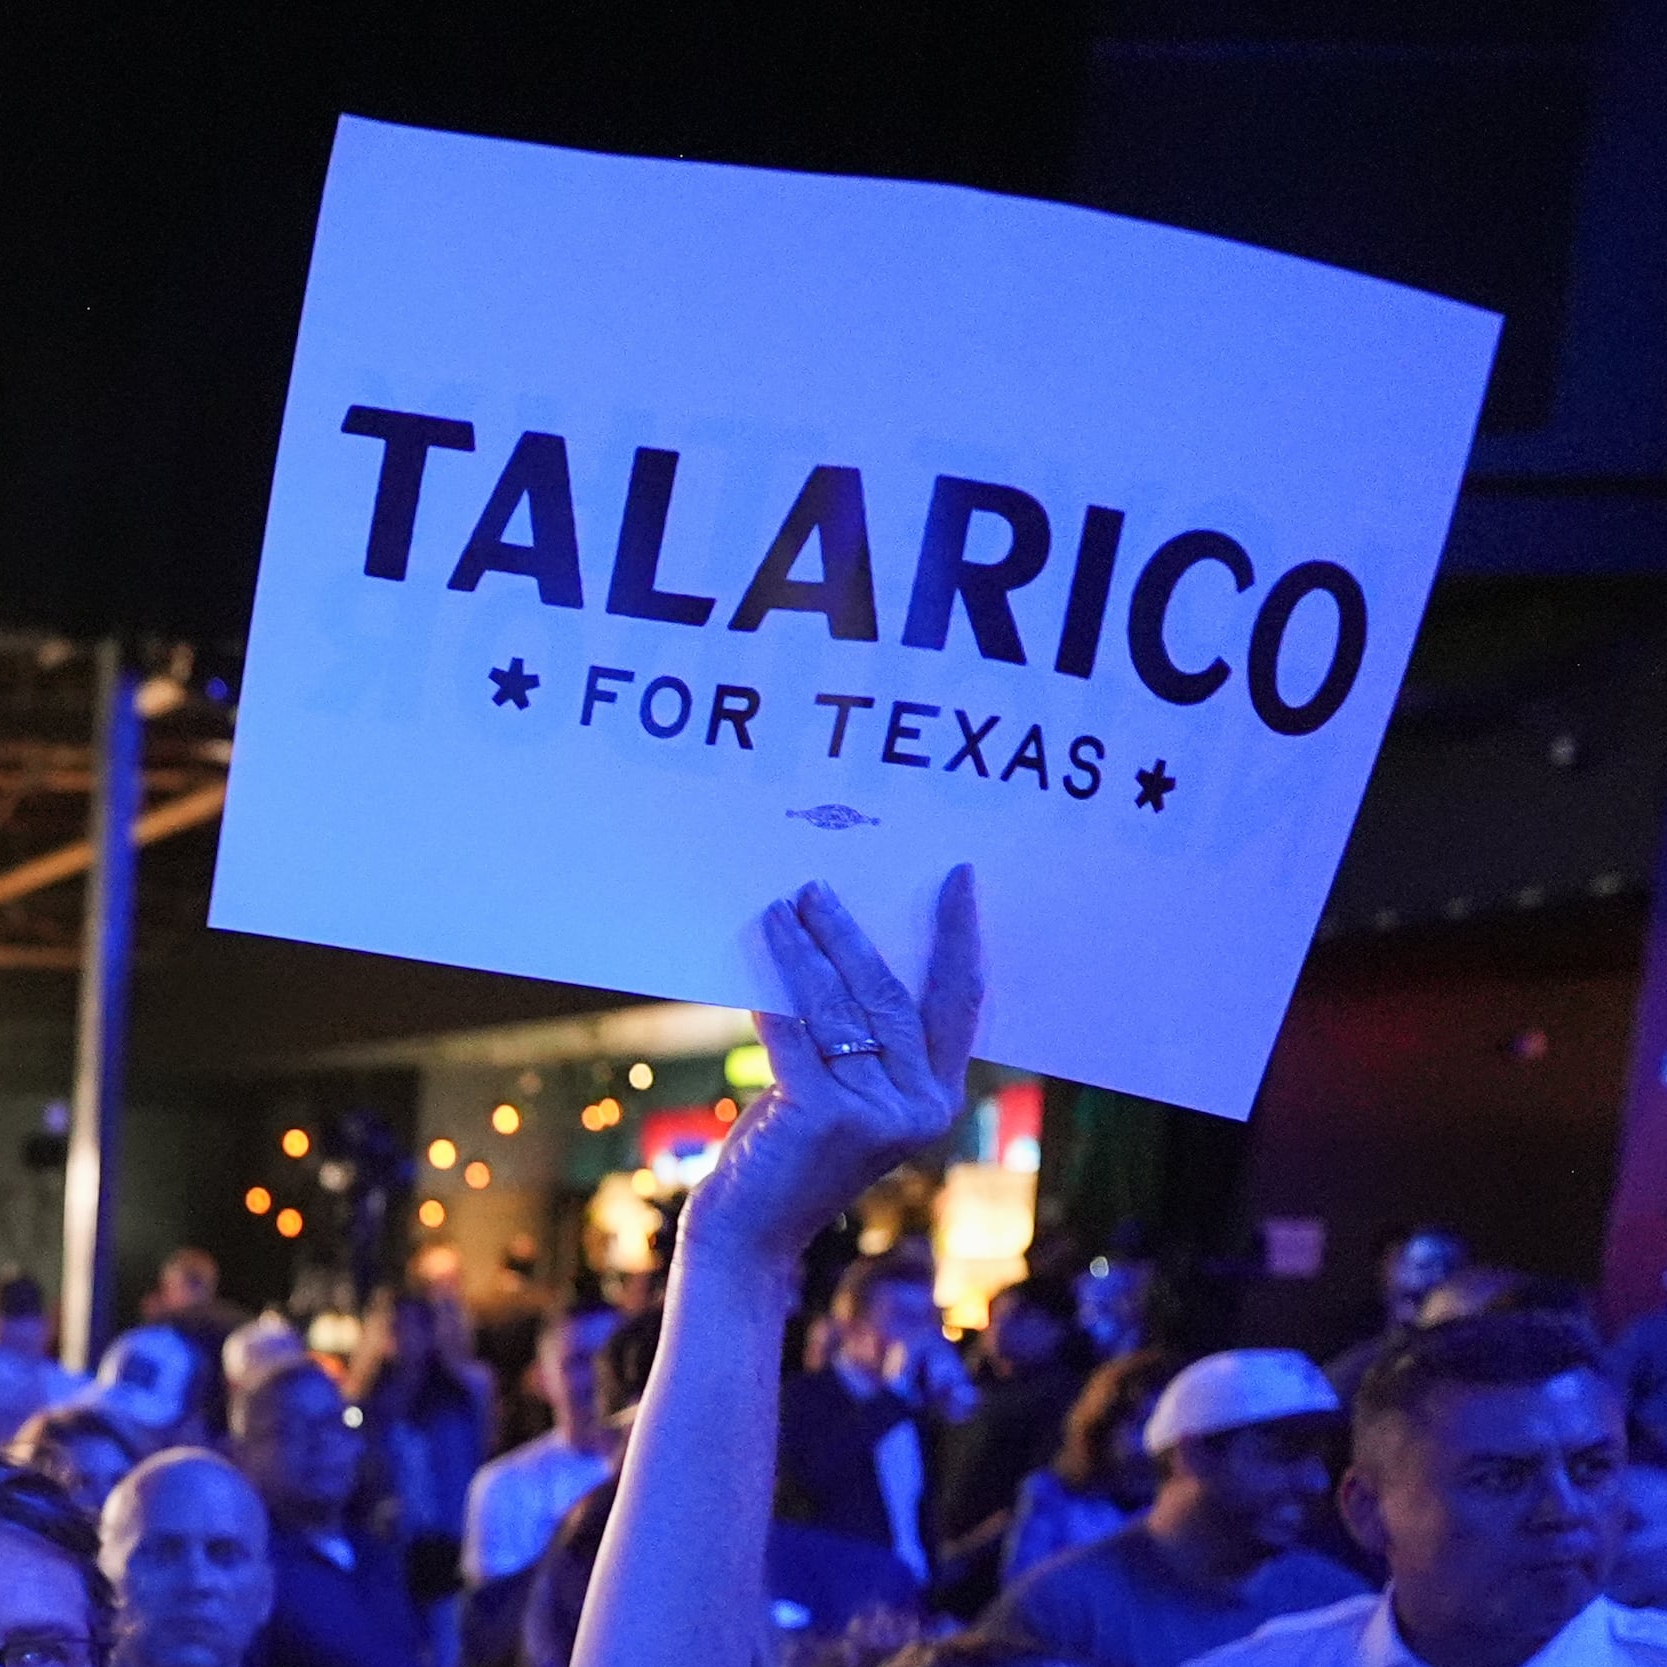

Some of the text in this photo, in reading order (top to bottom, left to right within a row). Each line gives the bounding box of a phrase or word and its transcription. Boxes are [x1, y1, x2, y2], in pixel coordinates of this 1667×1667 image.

[341, 404, 1368, 737] TALARICO
[579, 666, 1107, 800] FOR TEXAS
